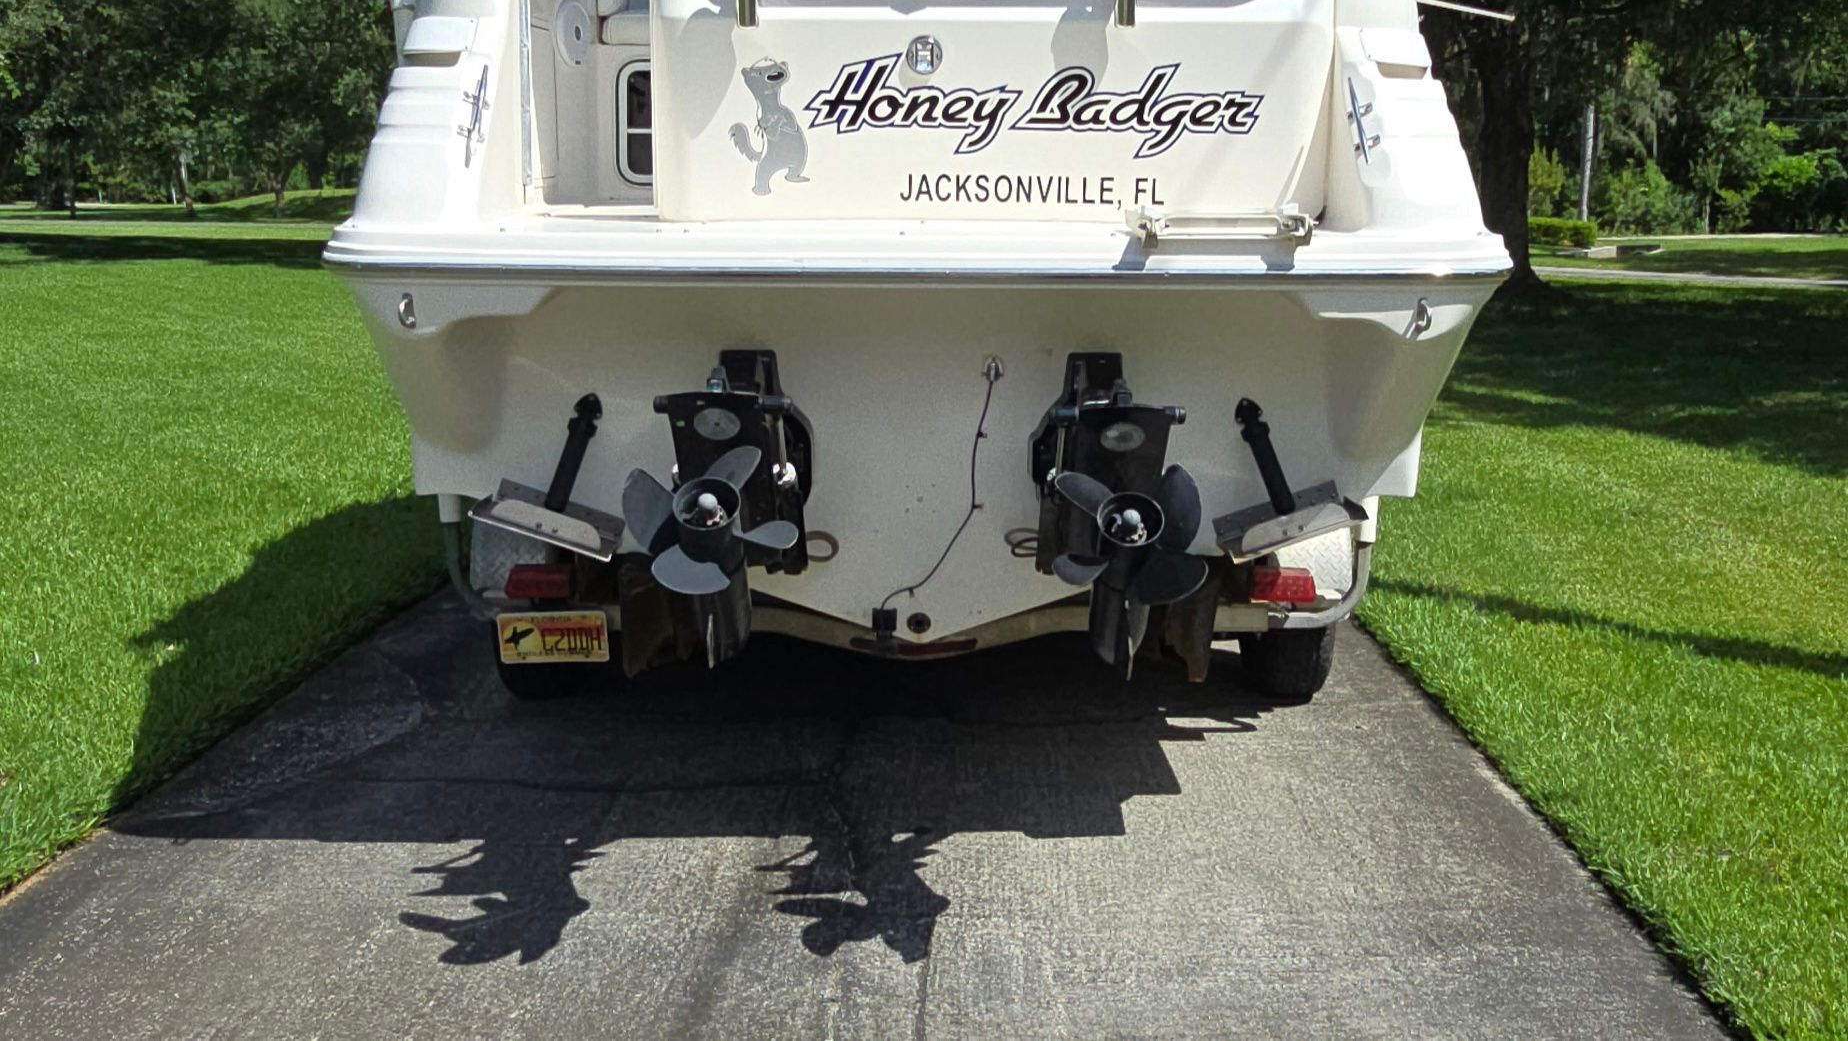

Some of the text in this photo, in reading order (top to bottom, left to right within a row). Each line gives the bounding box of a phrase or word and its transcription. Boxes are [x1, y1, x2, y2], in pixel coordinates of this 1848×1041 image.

[804, 52, 1263, 158] Honey Badger
[899, 173, 1165, 209] JACKSONVILLE, FL
